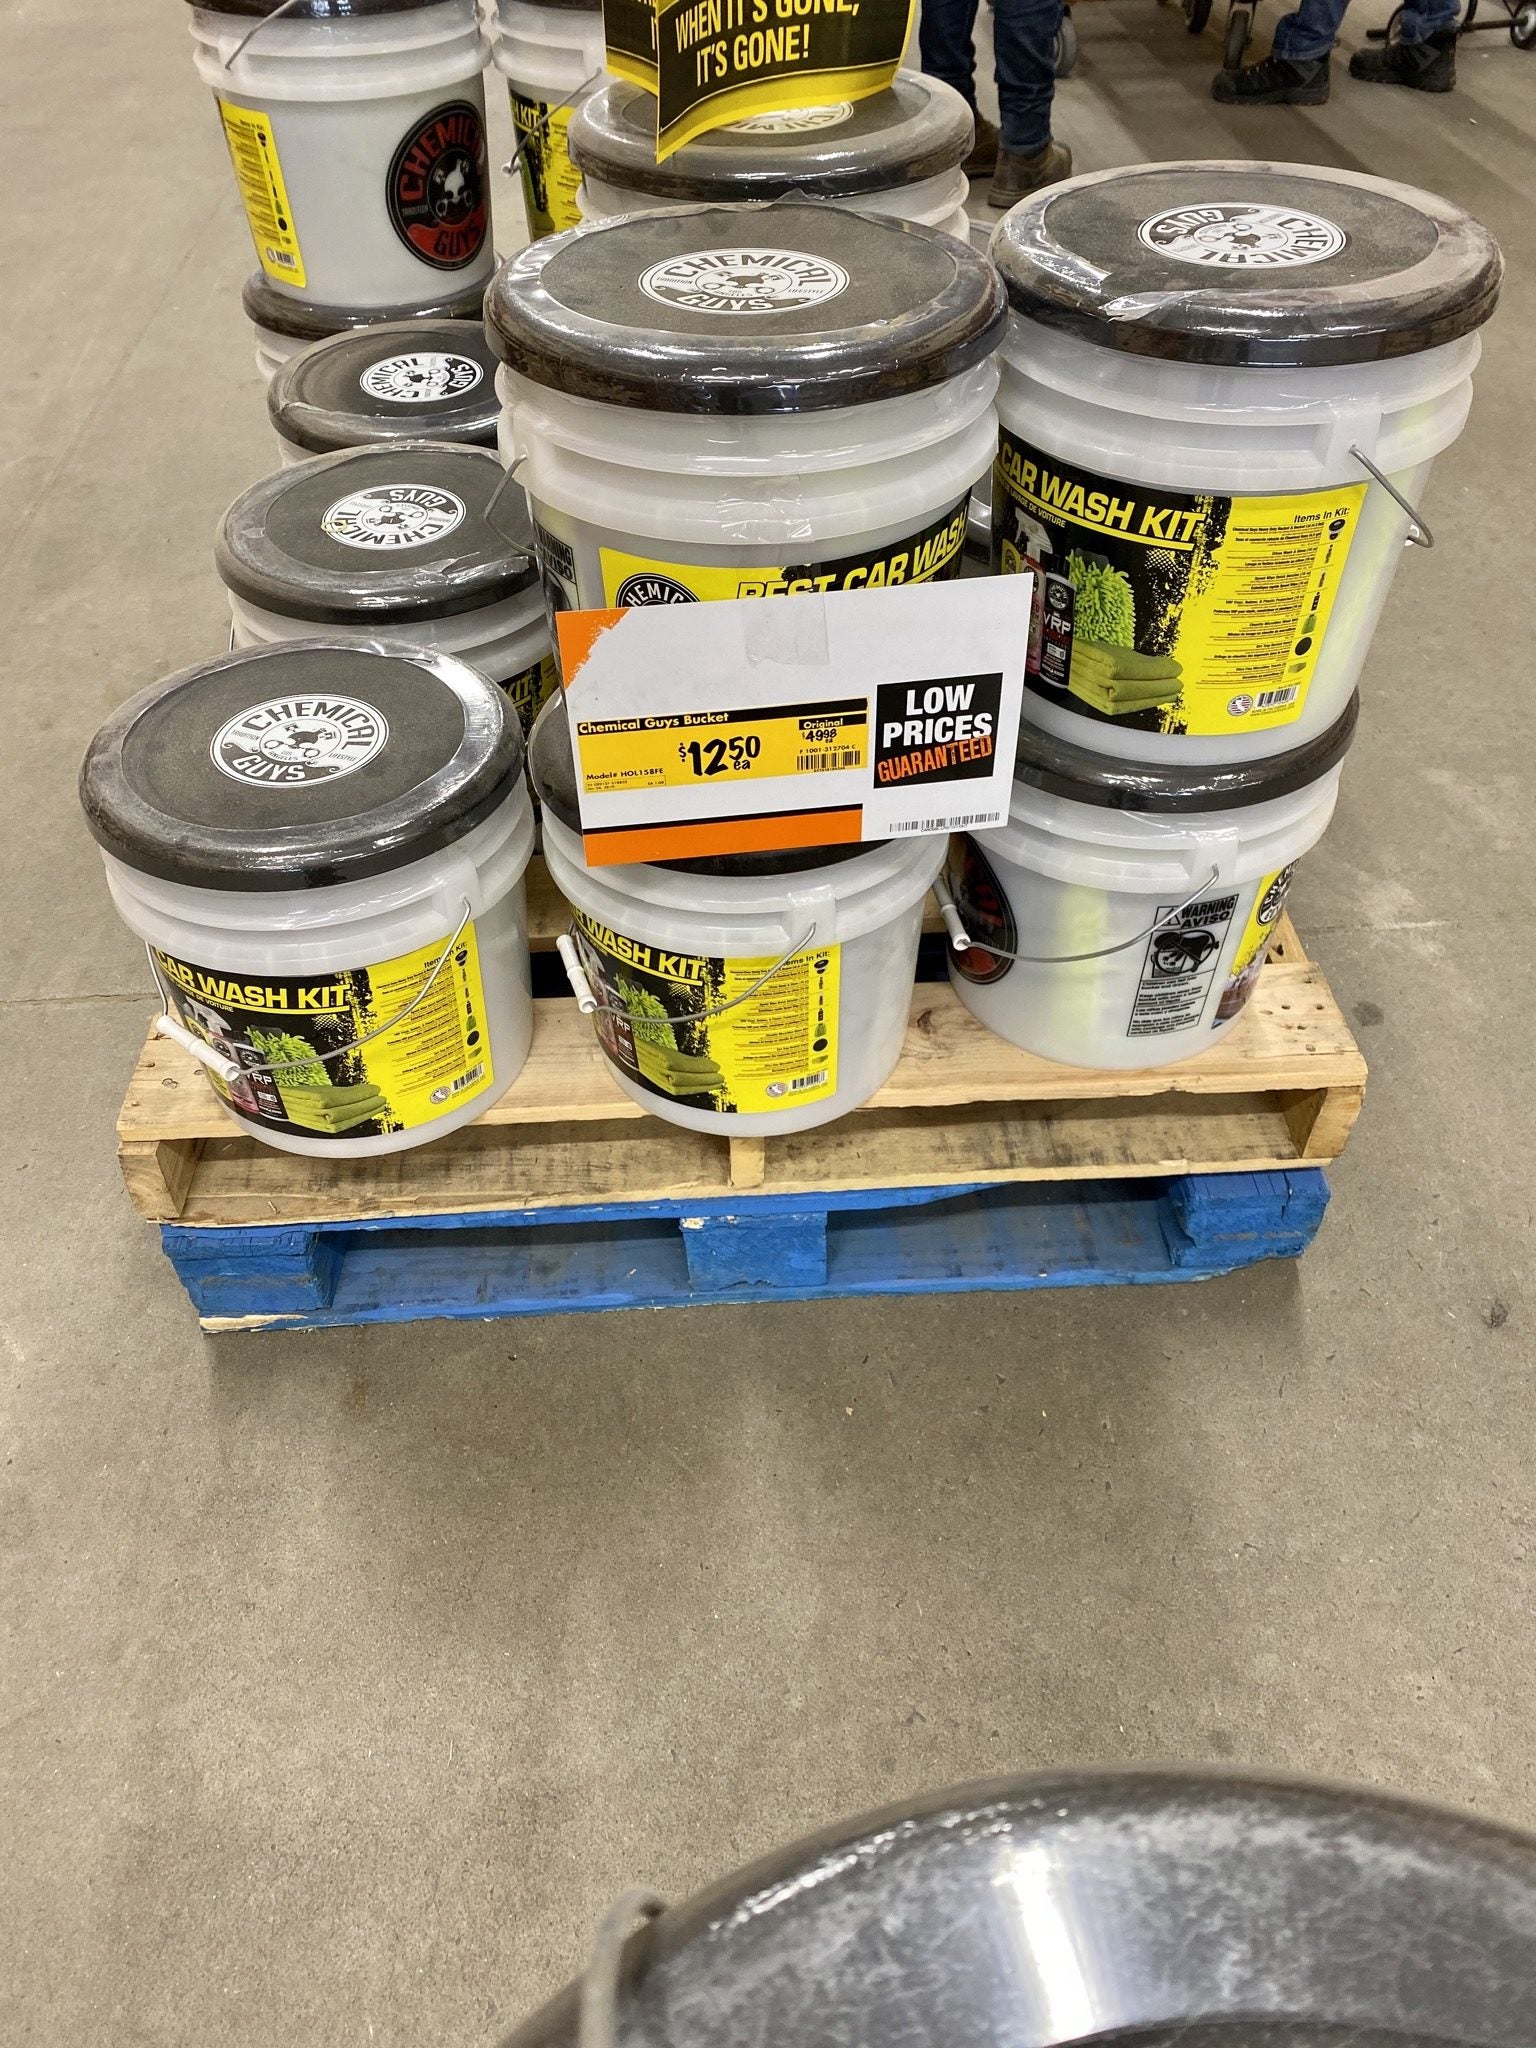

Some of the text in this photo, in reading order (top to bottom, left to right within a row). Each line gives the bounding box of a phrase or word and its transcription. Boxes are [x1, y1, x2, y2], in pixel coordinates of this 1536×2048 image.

[675, 0, 722, 53] WHEN
[727, 0, 768, 29] ITS
[696, 24, 810, 87] IT'S GONE!
[1156, 209, 1224, 234] GUYS
[1199, 217, 1329, 264] CHEMICAL
[663, 254, 832, 286] CHEMICAL
[677, 295, 774, 310] GUYS
[370, 357, 421, 398] CHEMICAL
[448, 363, 475, 388] GUYS
[389, 489, 448, 508] GUYS
[1001, 441, 1207, 542] CAR WASH KIT
[1038, 508, 1067, 528] VOITURE
[1293, 507, 1350, 524] Items In Kit:
[842, 552, 909, 591] CAR
[912, 505, 967, 577] WASH
[625, 582, 685, 608] HEMIC
[1043, 611, 1072, 635] VRP
[504, 673, 532, 704] KIT
[906, 683, 975, 716] LOW
[241, 701, 375, 750] CHEMICAL
[578, 712, 730, 734] Chemical Guys Bucket
[803, 717, 844, 729] Original
[882, 712, 993, 748] PRICES
[232, 754, 306, 780] GUYS
[733, 759, 751, 770] ea
[877, 734, 993, 783] GUARANTEED
[586, 771, 618, 780] Model#
[1180, 911, 1230, 929] AVISO
[1181, 897, 1236, 919] WARNING
[586, 914, 652, 968] WASH
[658, 952, 706, 980] KIT
[783, 957, 804, 966] ems
[816, 950, 830, 959] Kit:
[424, 956, 442, 968] Item
[156, 948, 350, 1009] CAR WASH KIT
